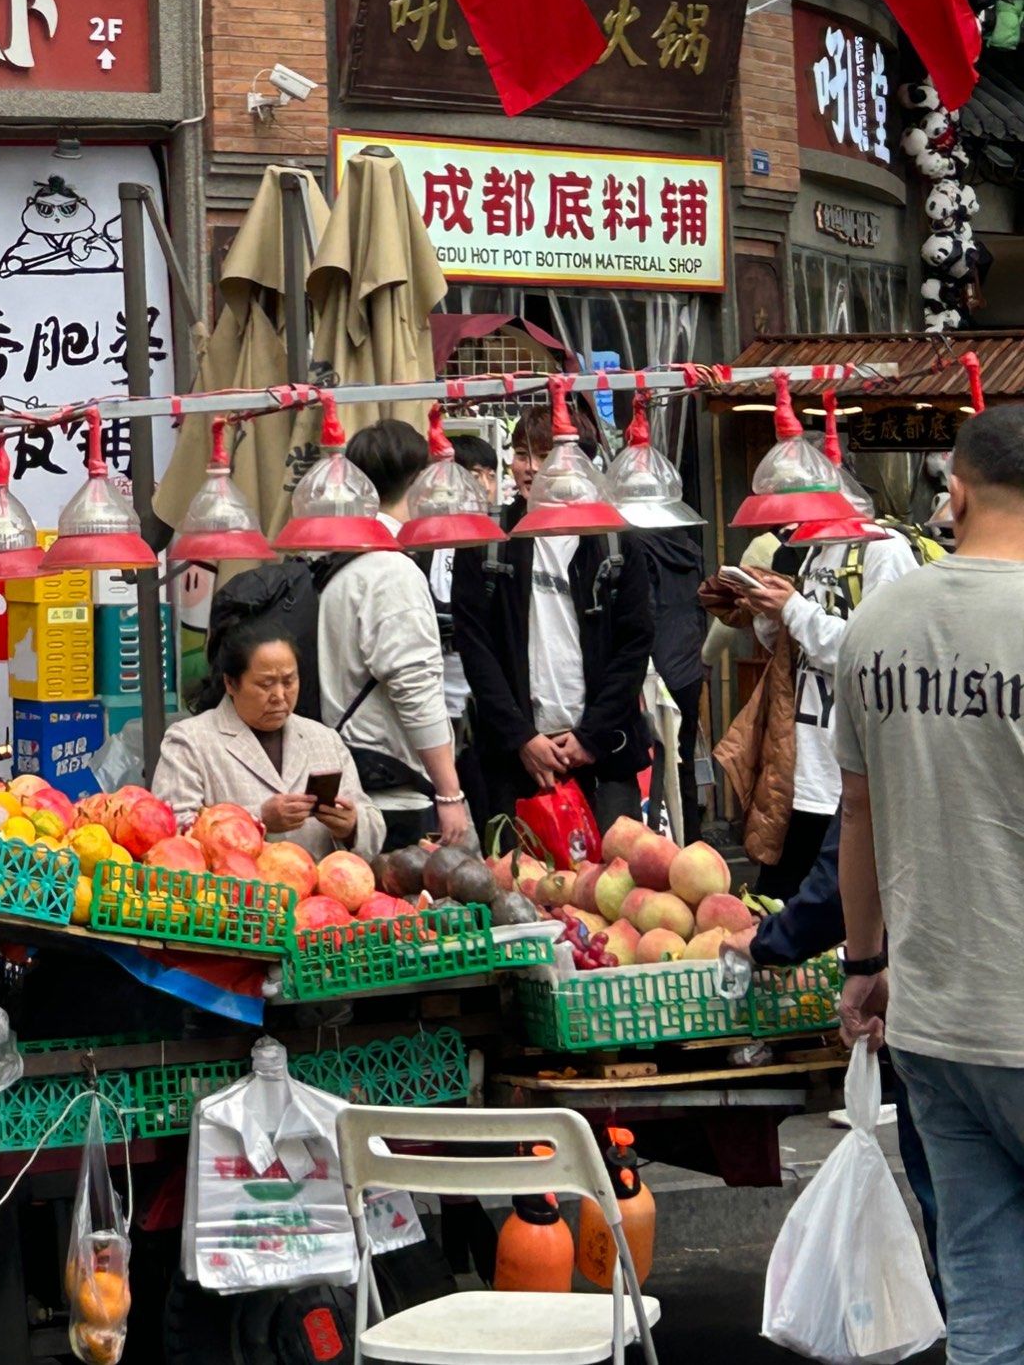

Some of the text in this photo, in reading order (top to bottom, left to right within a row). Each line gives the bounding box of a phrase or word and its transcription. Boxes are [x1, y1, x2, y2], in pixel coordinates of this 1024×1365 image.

[89, 18, 122, 42] 2F
[422, 162, 709, 247] 成都底料铺
[433, 246, 703, 274] GDU HOT POT BOTTOM MATERIAL SHOP
